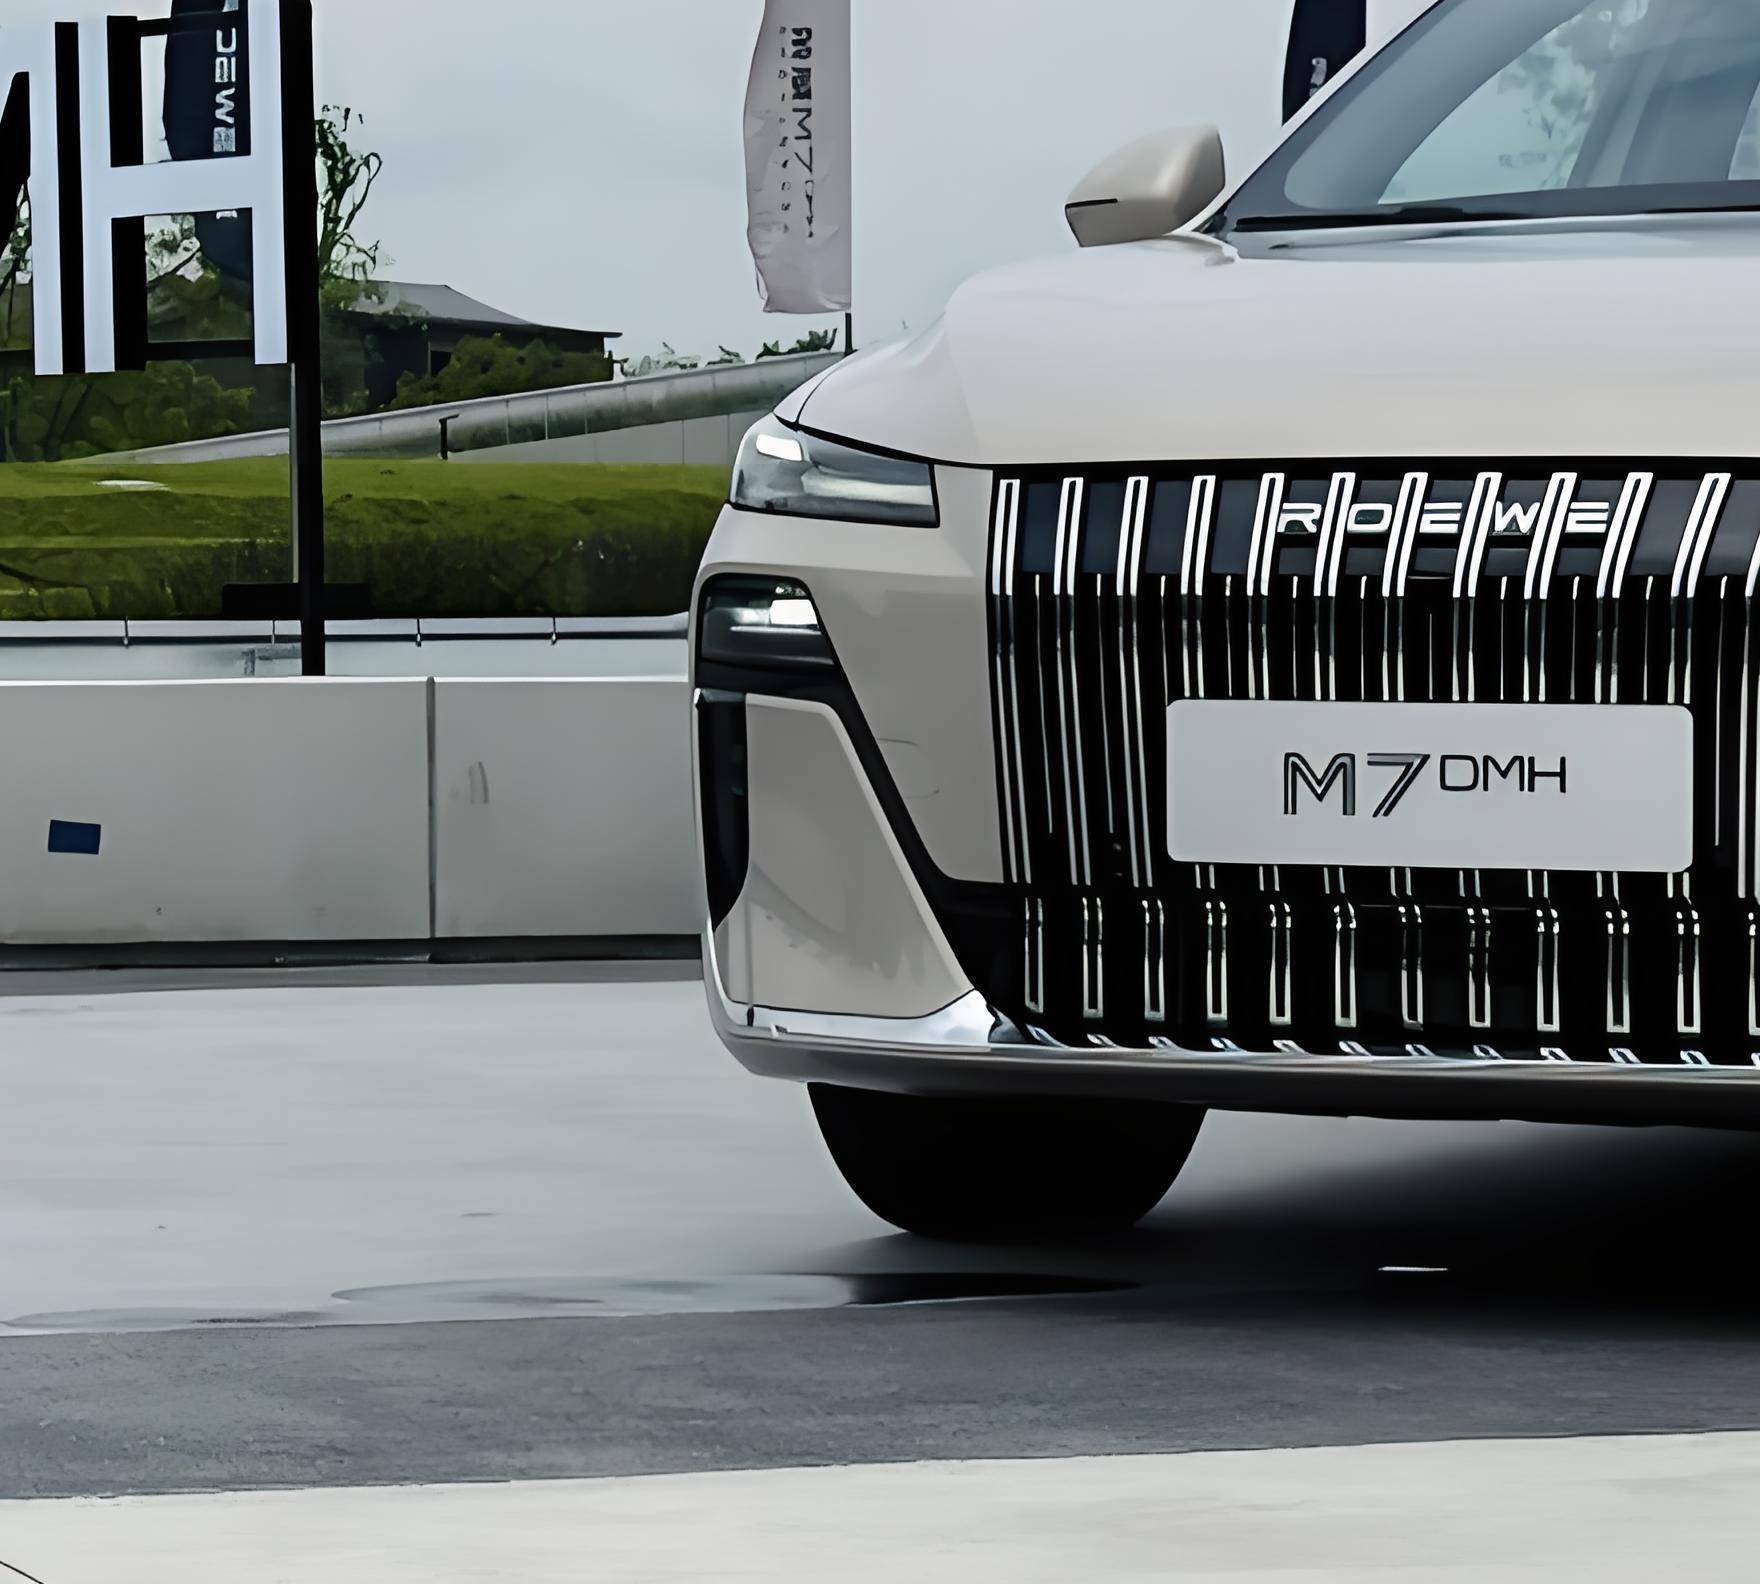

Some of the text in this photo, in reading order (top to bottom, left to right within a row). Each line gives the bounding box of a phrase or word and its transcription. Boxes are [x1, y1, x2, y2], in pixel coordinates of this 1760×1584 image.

[1276, 500, 1610, 535] ROEWE
[1283, 751, 1567, 818] M7 DMH
